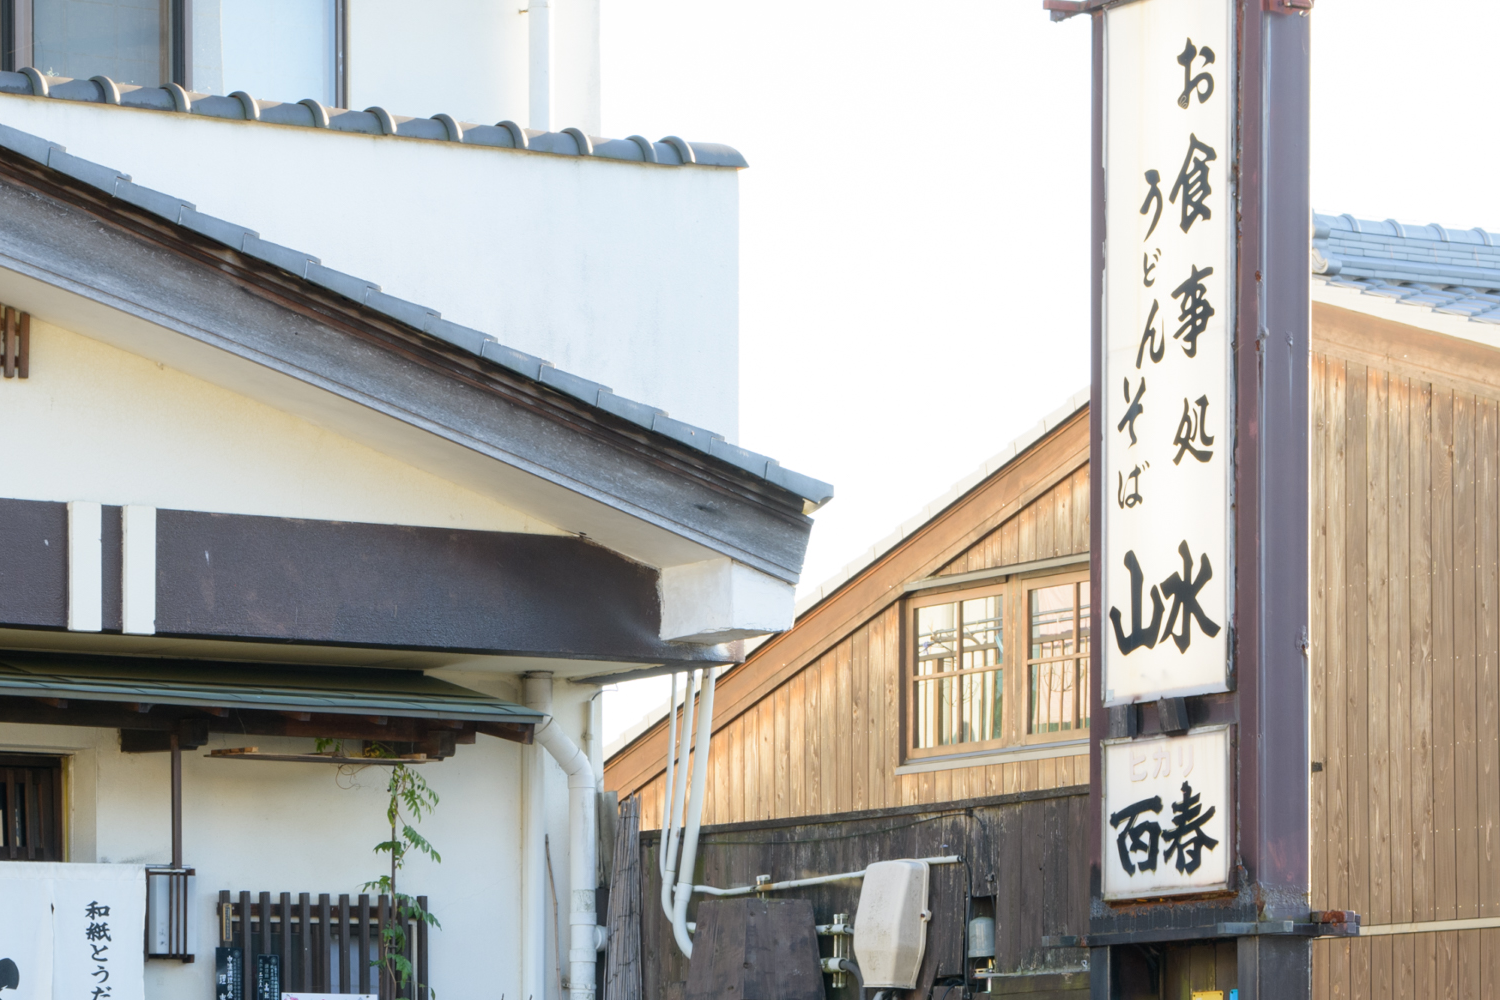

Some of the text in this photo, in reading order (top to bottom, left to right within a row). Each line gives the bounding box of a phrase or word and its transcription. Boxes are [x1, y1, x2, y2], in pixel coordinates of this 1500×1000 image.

[1170, 39, 1217, 466] お食事処
[1110, 541, 1221, 656] 山水
[1111, 783, 1219, 878] 百春
